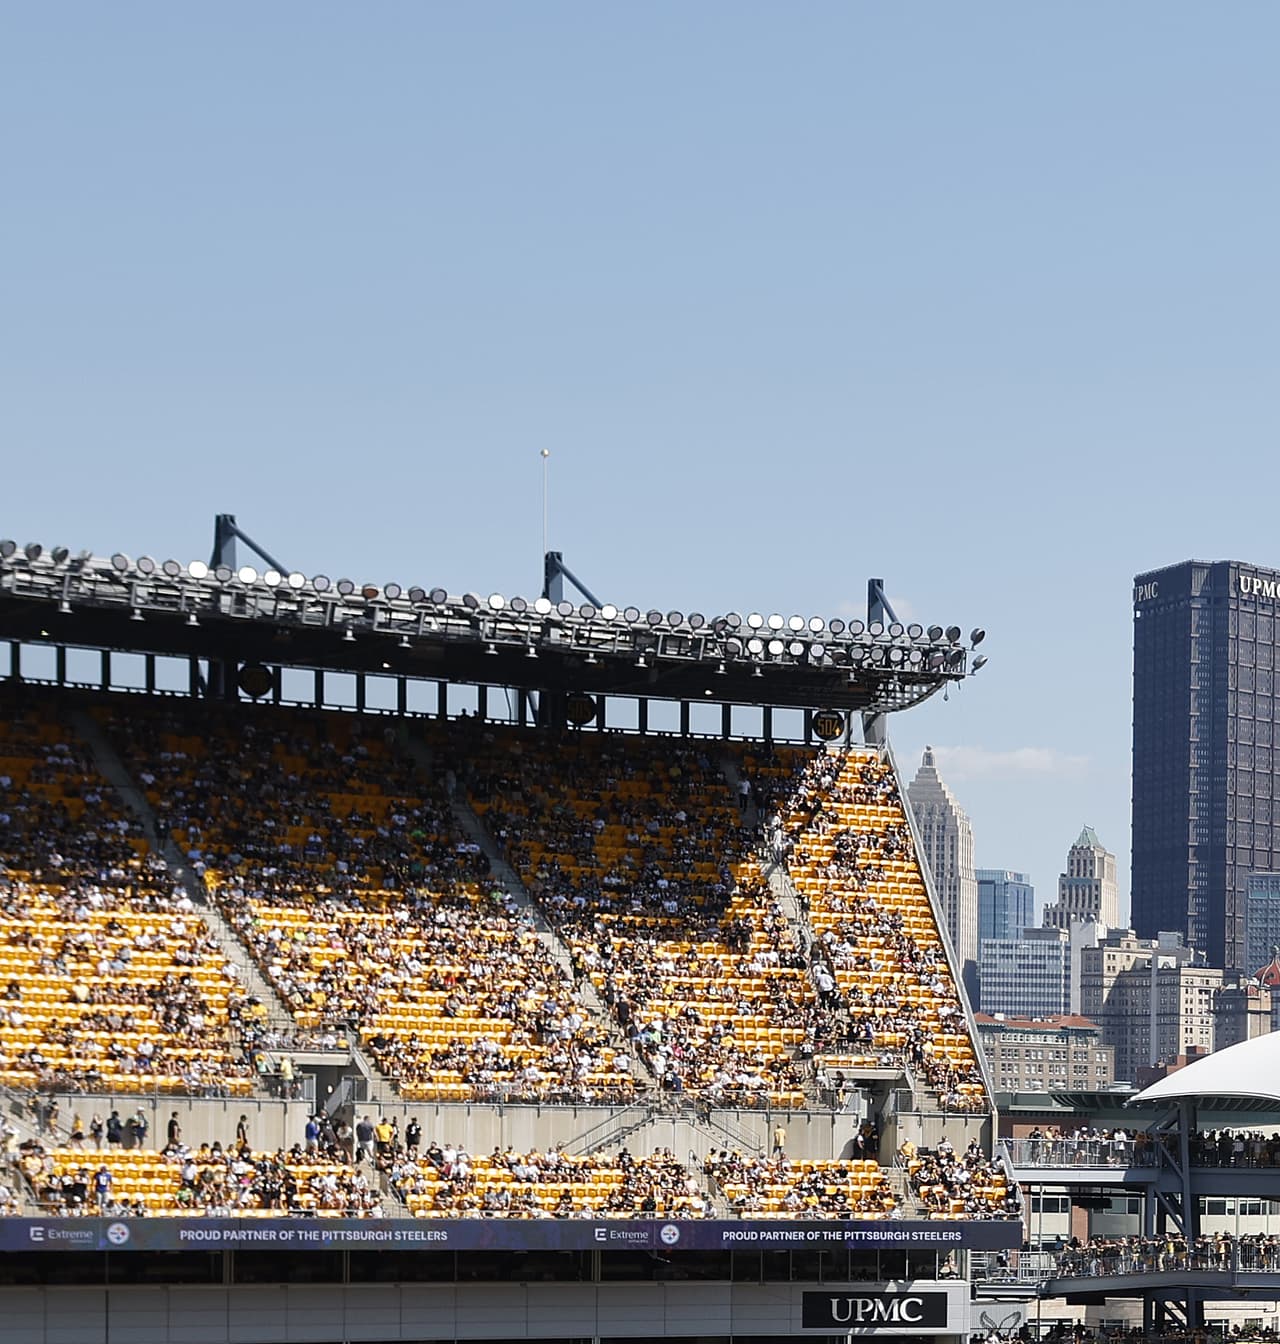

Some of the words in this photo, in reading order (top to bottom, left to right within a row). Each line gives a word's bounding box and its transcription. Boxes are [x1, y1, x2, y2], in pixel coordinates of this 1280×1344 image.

[818, 717, 841, 736] 504
[49, 1229, 94, 1241] Extreme
[180, 1230, 222, 1241] PROUD
[224, 1230, 277, 1241] PARTNER
[279, 1230, 296, 1241] OF
[298, 1230, 320, 1241] THE
[322, 1230, 393, 1242] PITTSBURGH
[394, 1230, 448, 1242] STEELERS
[610, 1229, 649, 1241] Extreme
[722, 1231, 758, 1242] PROUD
[760, 1231, 805, 1242] PARTNER
[806, 1231, 822, 1242] OF
[824, 1231, 842, 1242] THE
[844, 1231, 910, 1242] PITTSBURGH
[911, 1231, 962, 1242] STEELERS
[831, 1297, 924, 1323] UPMC
